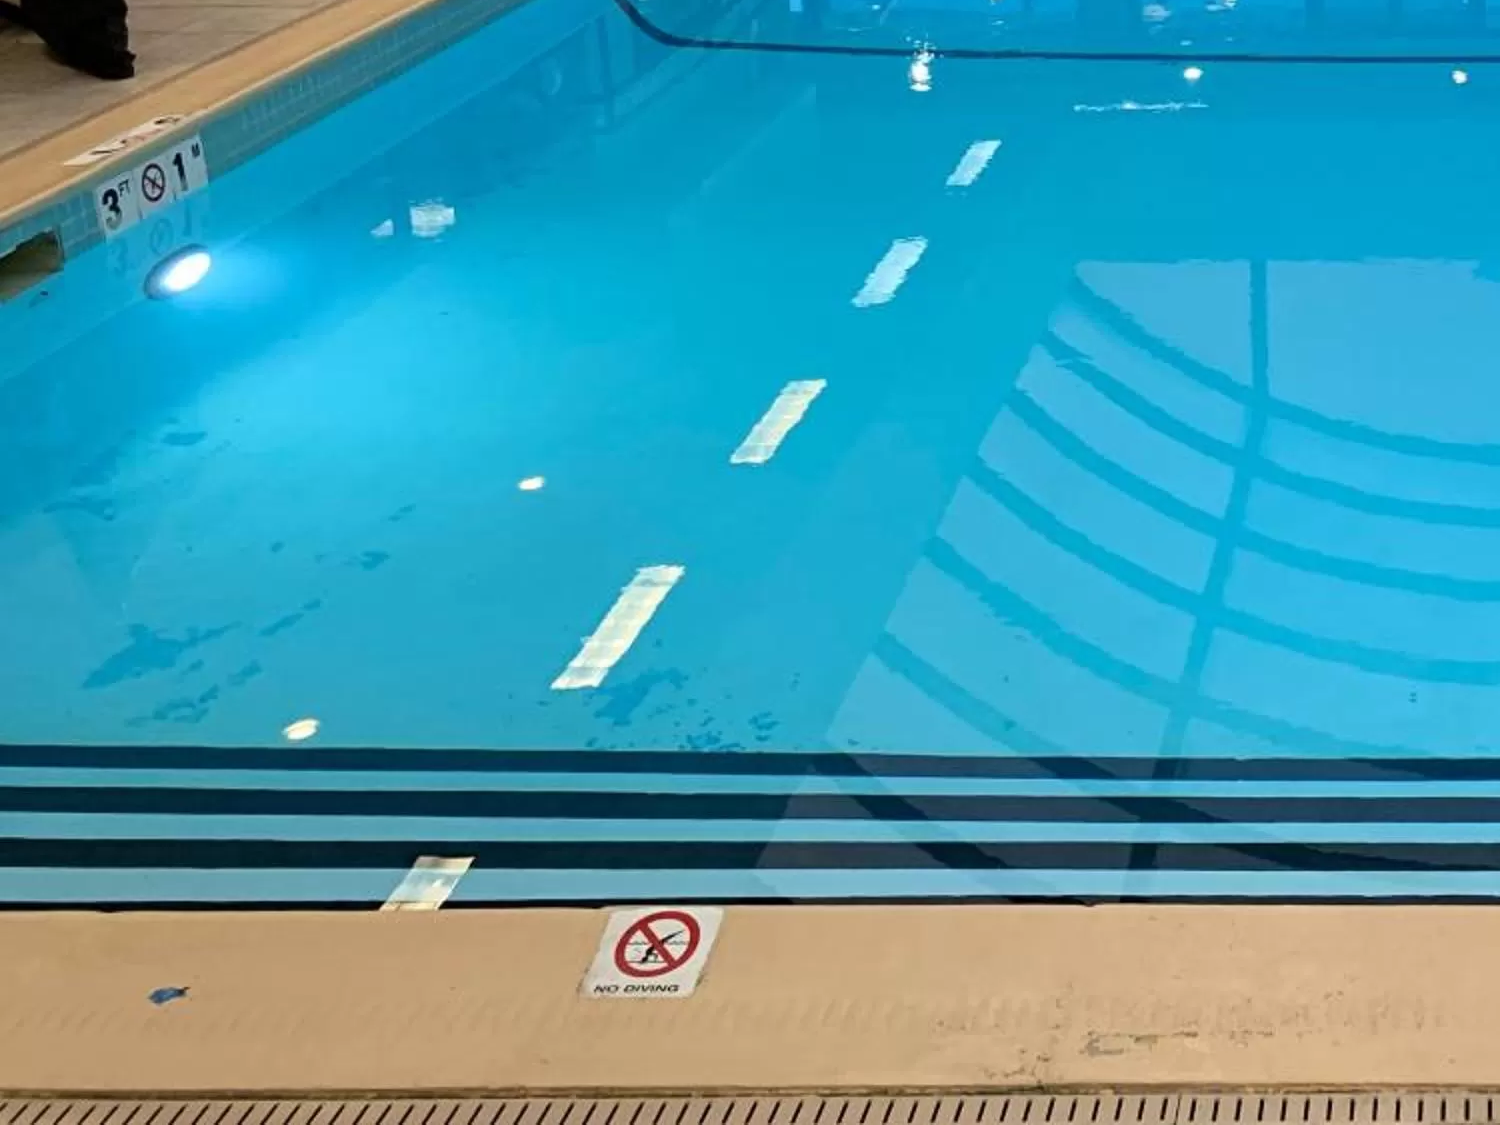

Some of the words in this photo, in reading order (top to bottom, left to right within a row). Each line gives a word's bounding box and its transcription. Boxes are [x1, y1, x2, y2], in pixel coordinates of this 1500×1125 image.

[173, 152, 188, 192] 1
[102, 188, 123, 230] 3
[593, 984, 619, 993] NO
[623, 984, 680, 993] DIVING
